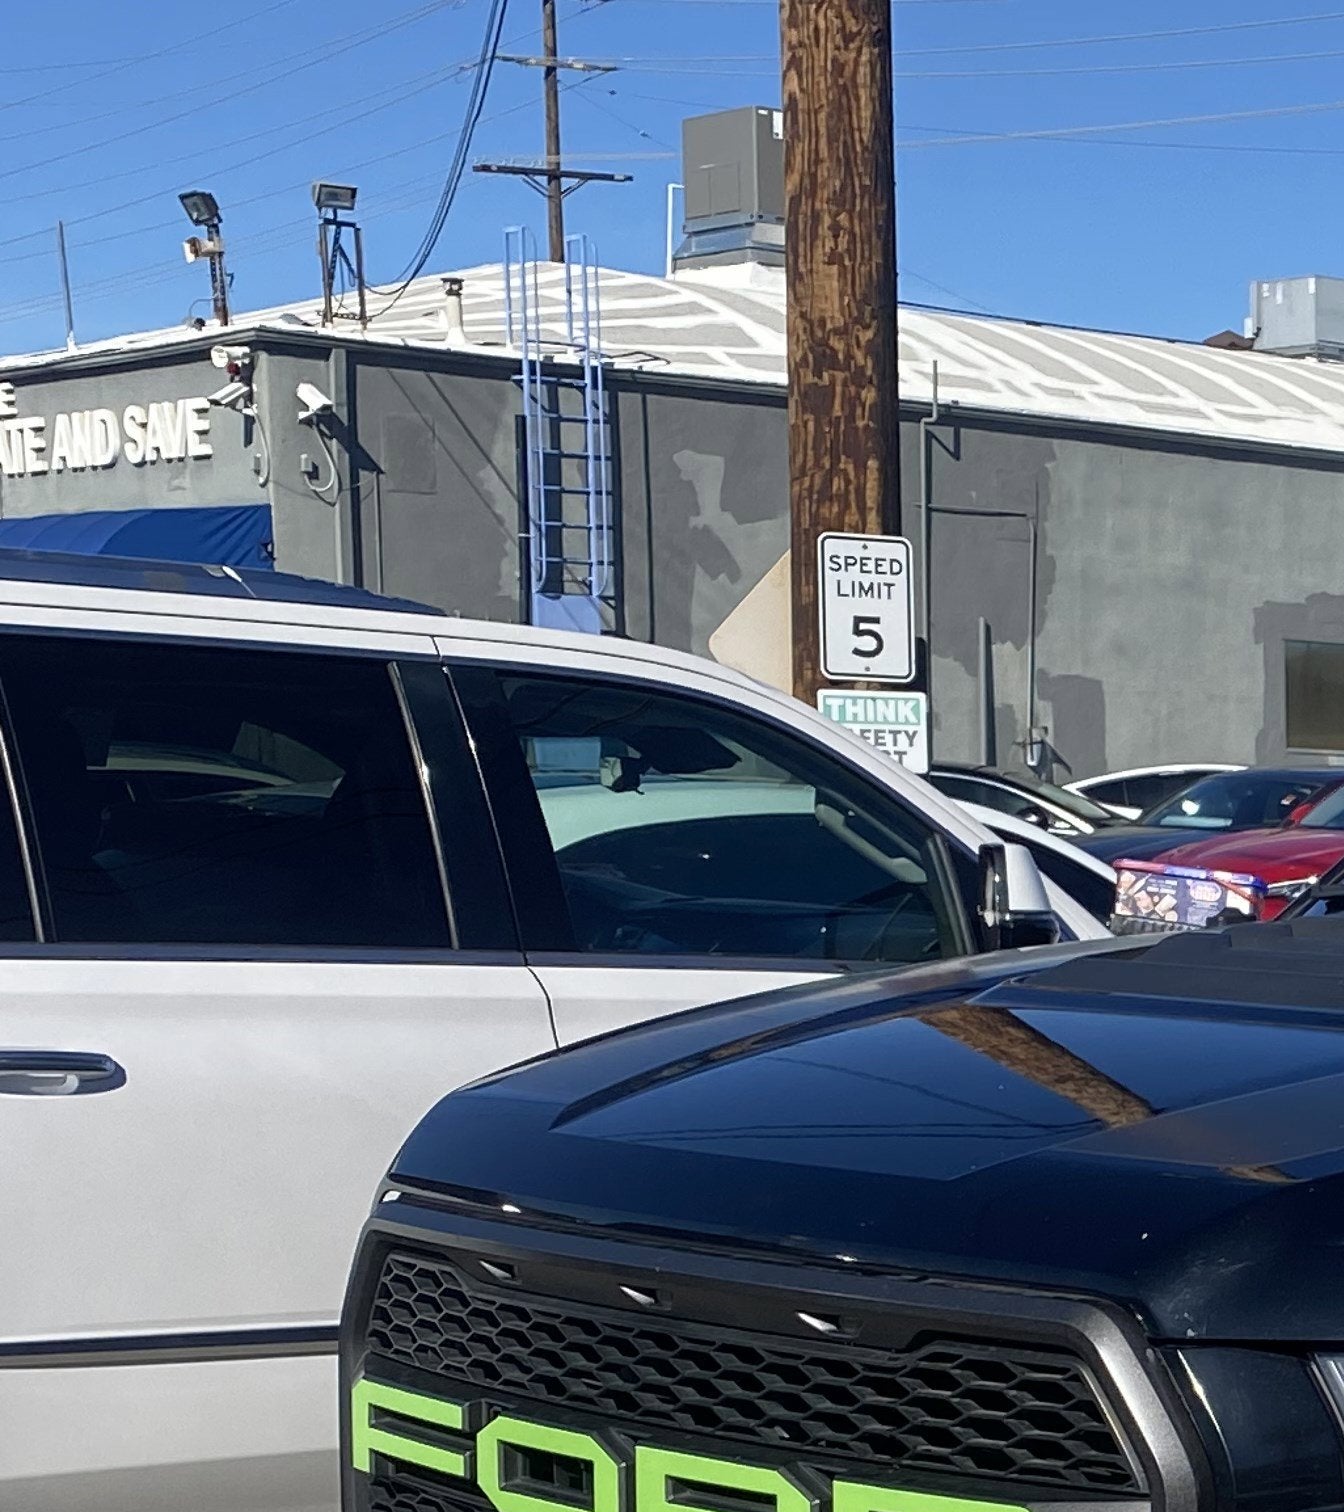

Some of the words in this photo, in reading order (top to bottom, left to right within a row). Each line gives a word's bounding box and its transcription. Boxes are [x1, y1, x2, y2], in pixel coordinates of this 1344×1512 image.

[51, 407, 121, 471] AND
[123, 396, 213, 465] SAVE
[828, 554, 903, 576] SPEED
[837, 579, 896, 600] LIMIT
[851, 615, 885, 658] 5
[825, 697, 919, 723] THINK
[847, 728, 918, 747] FETY
